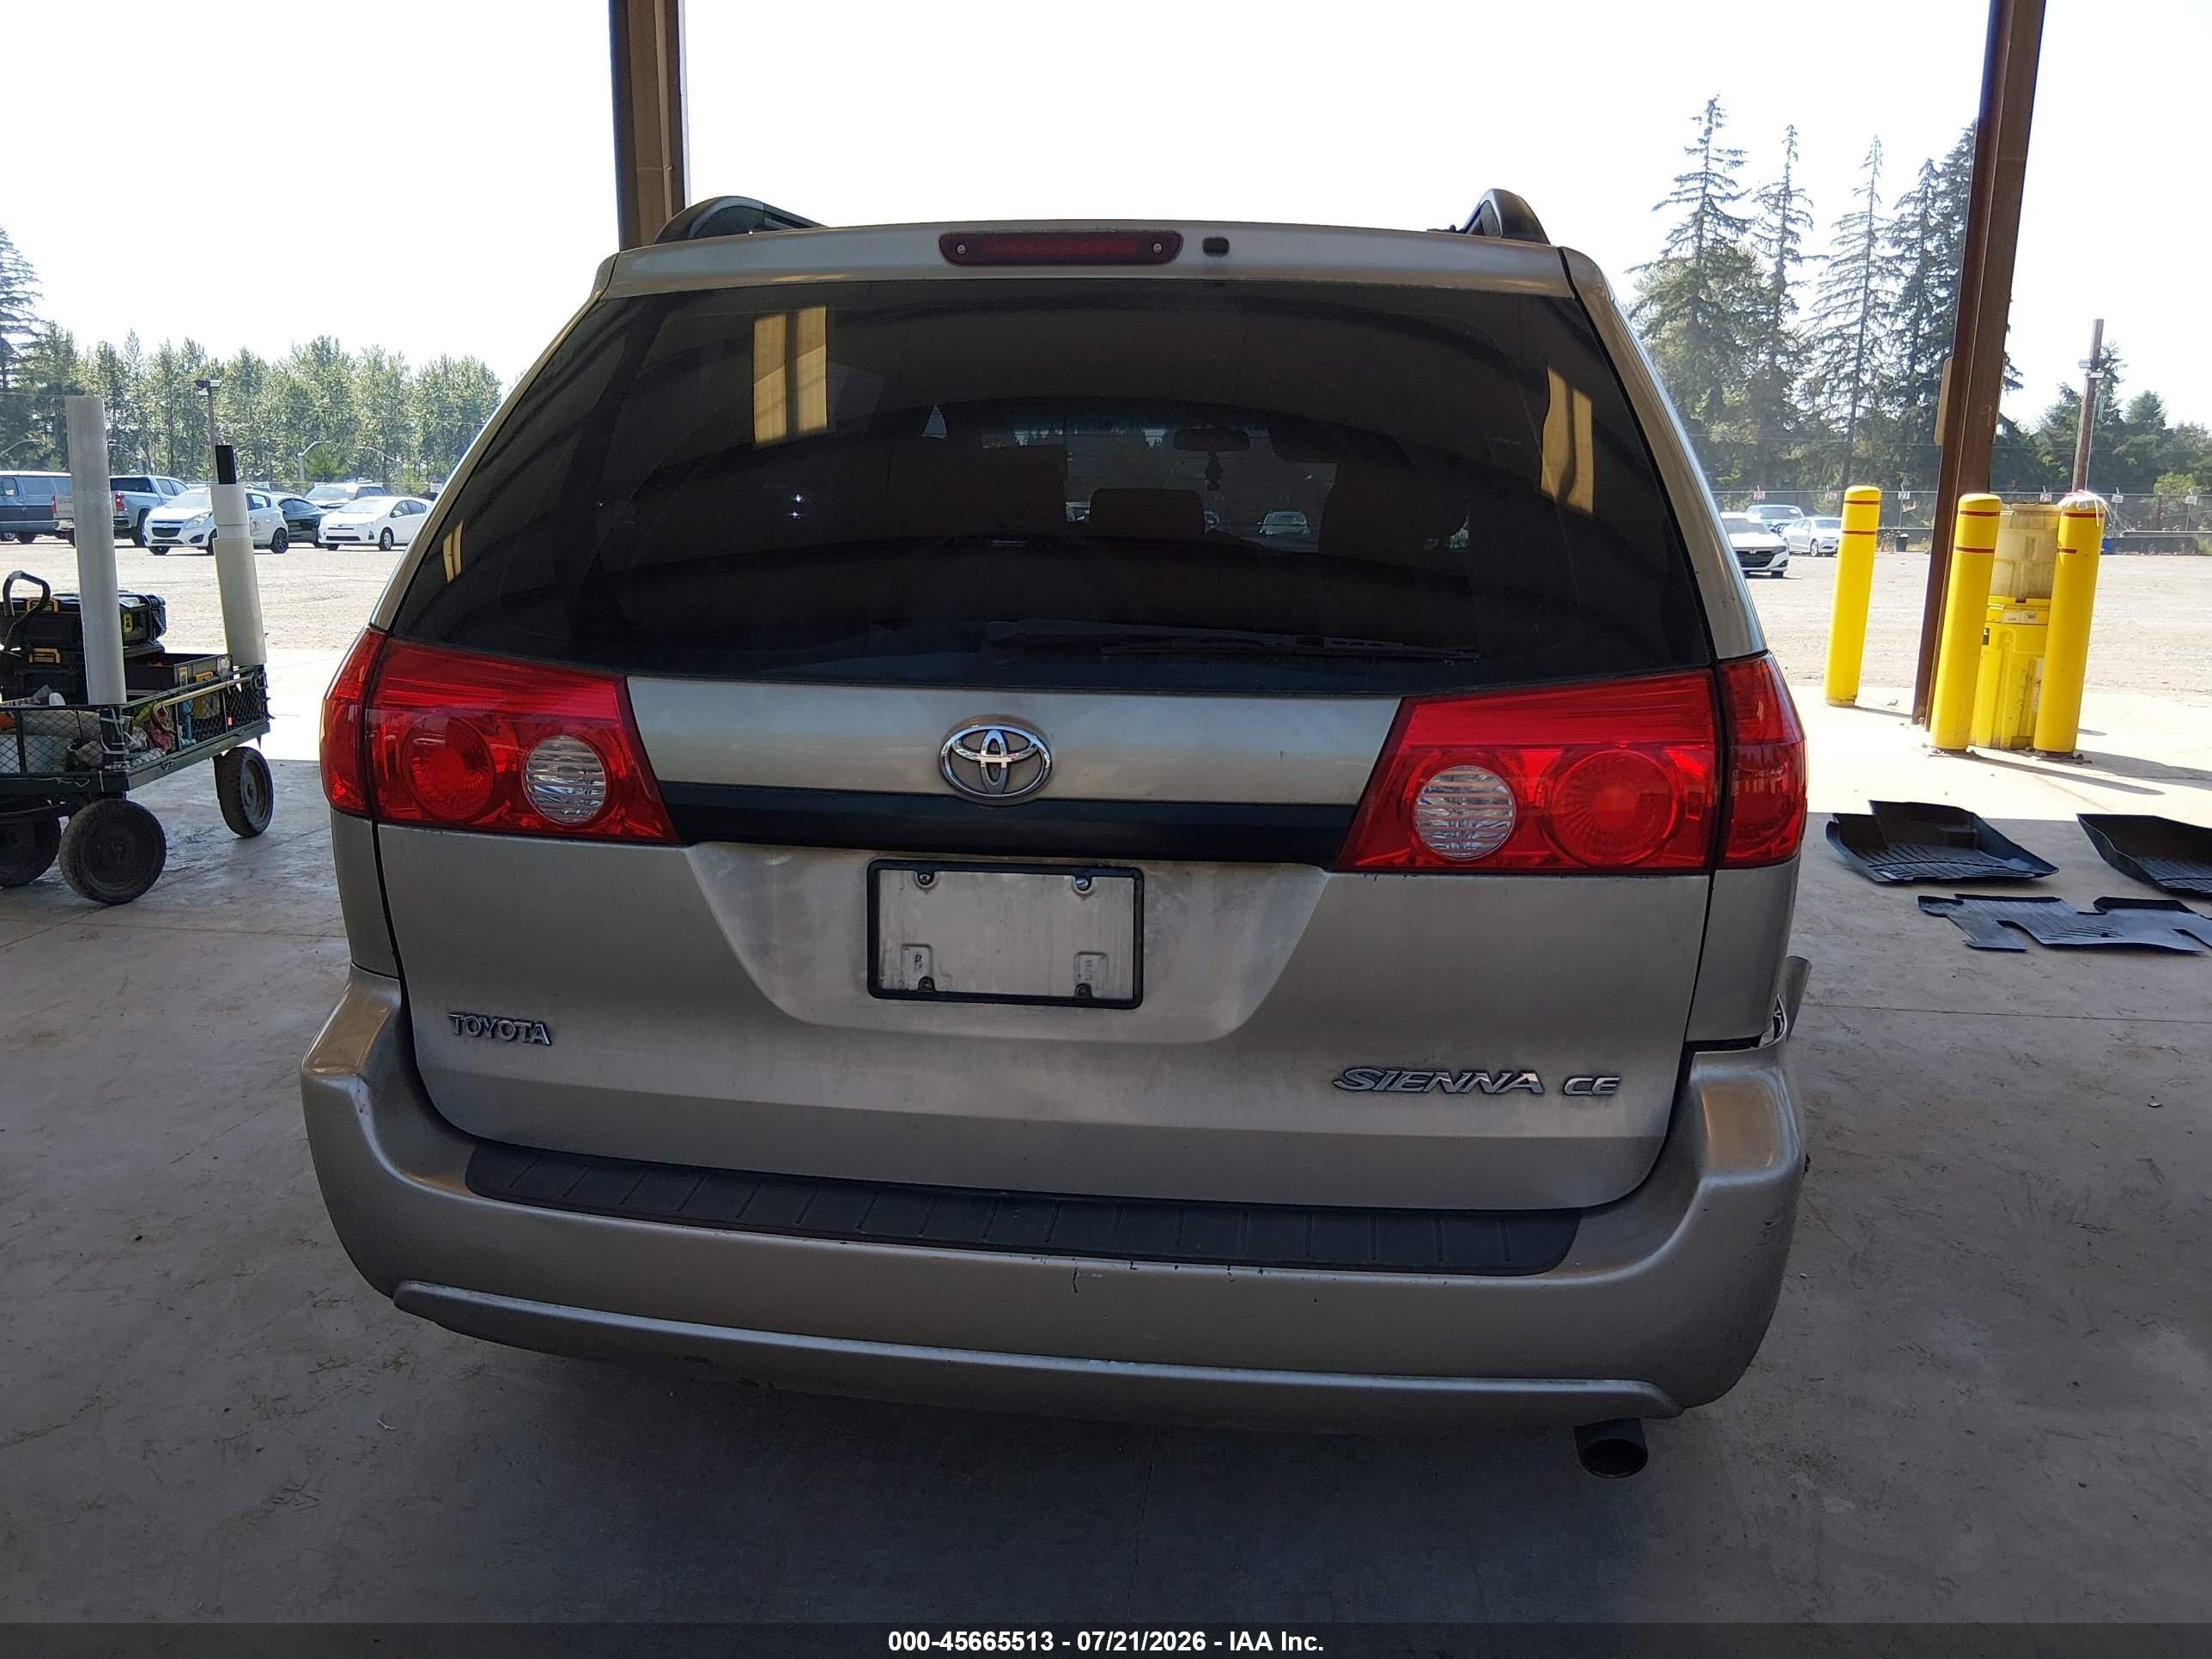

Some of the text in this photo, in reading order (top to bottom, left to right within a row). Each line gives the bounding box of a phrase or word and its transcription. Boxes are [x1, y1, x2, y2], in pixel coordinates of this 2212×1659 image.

[447, 1012, 552, 1046] TOYOTA
[1332, 1067, 1621, 1096] SIENNA CE
